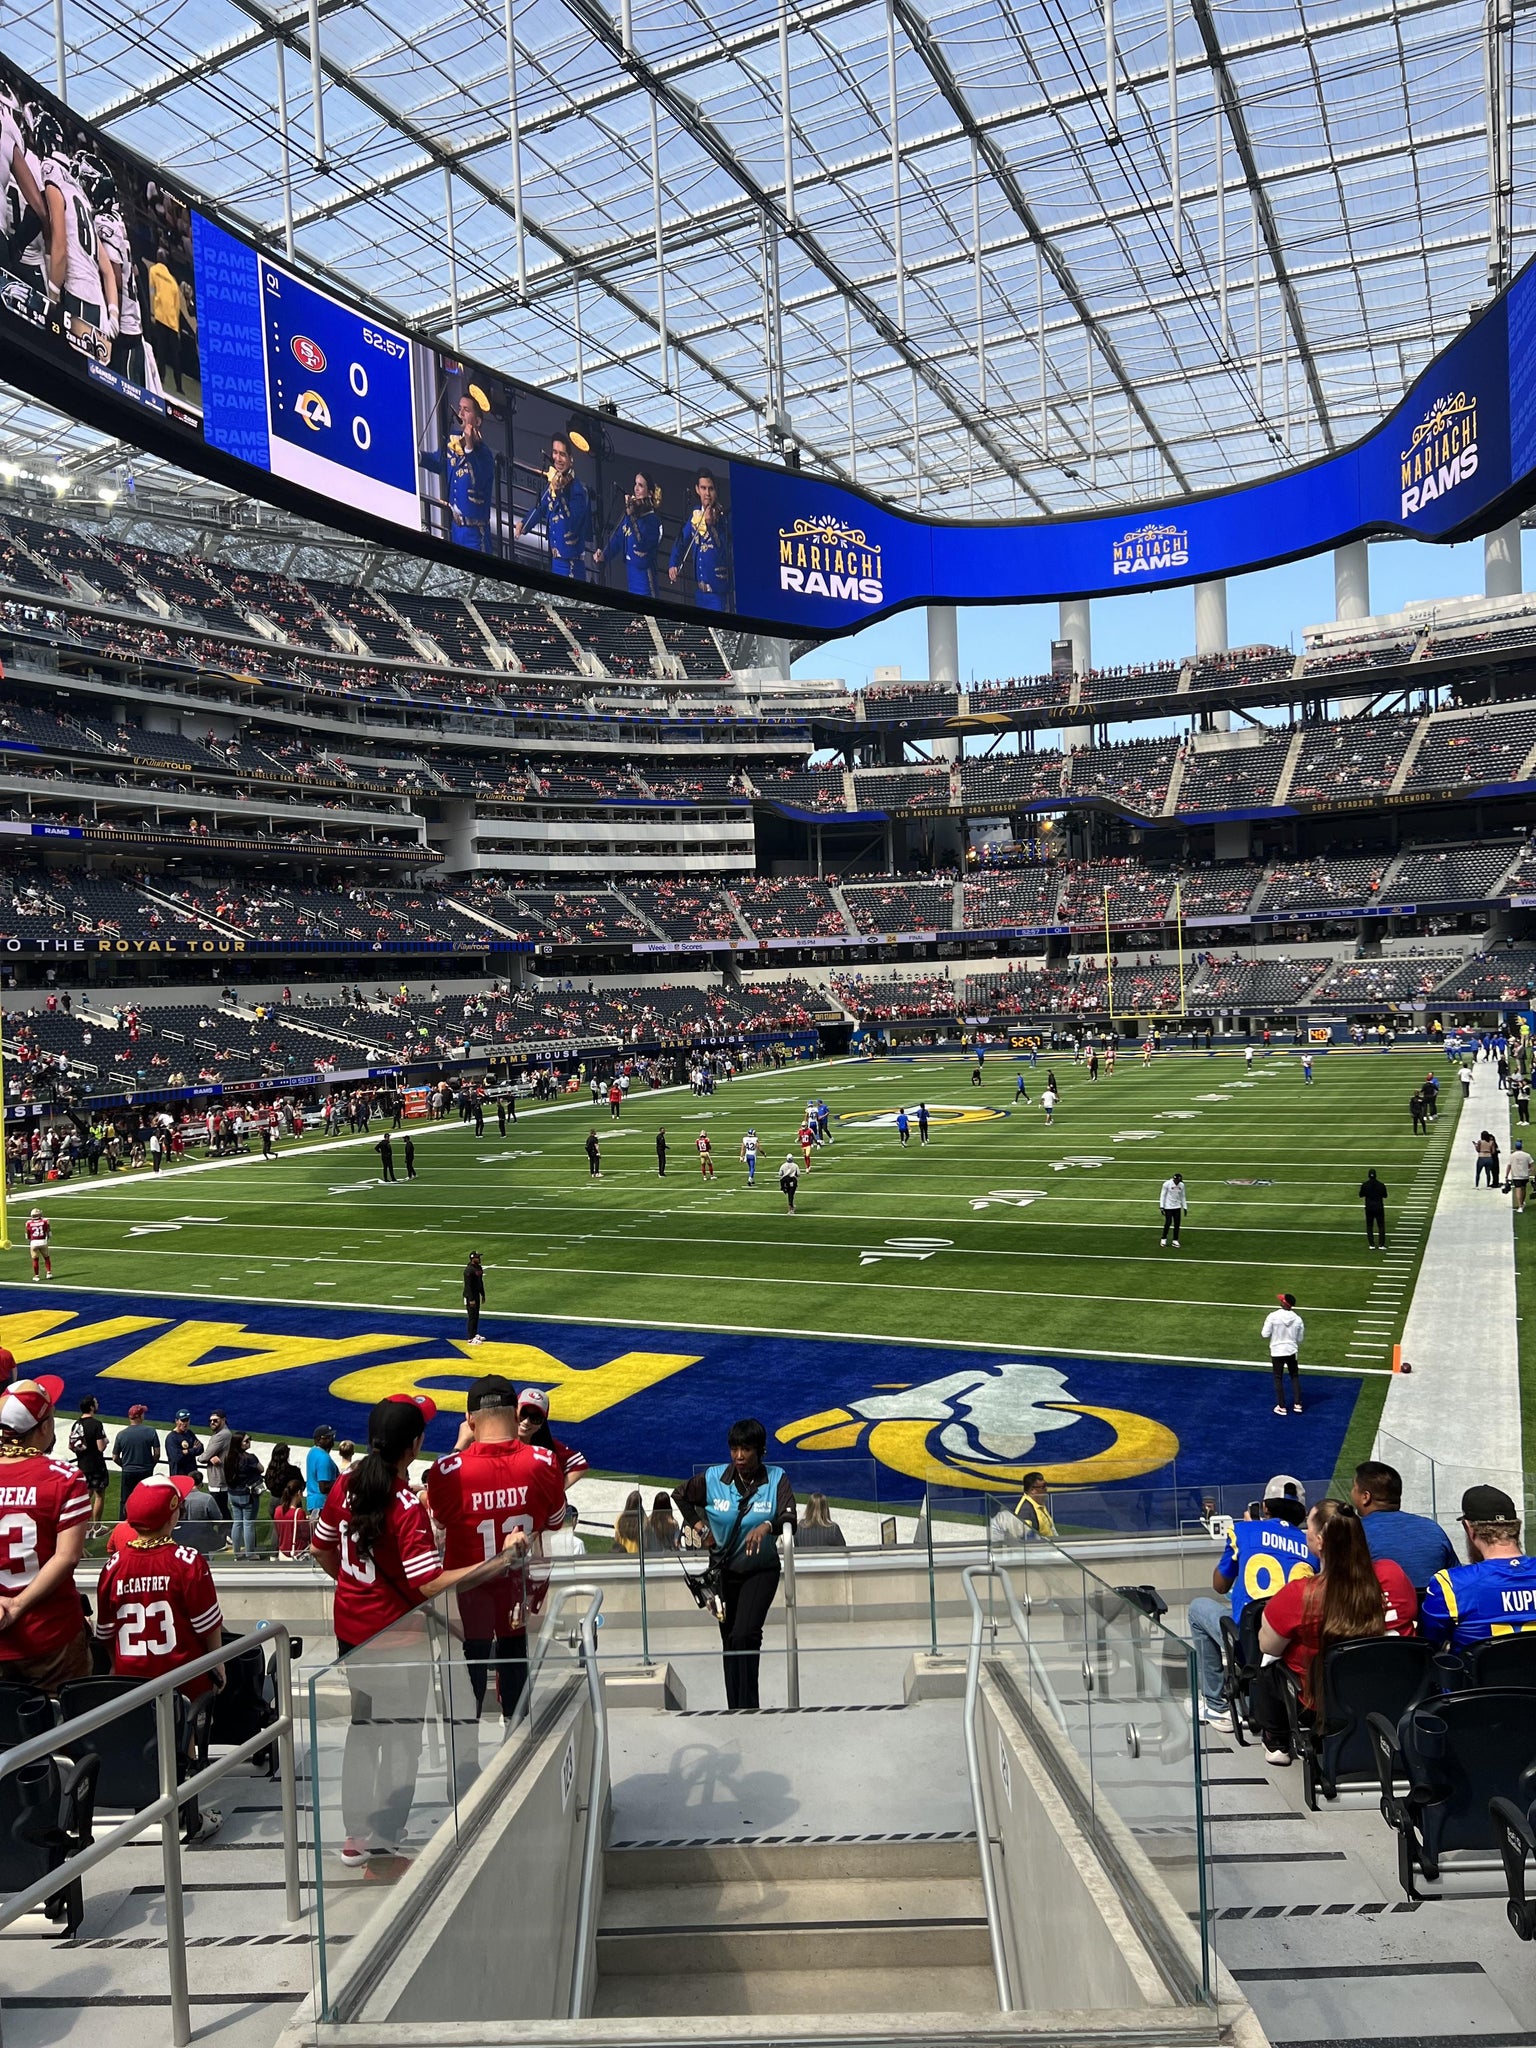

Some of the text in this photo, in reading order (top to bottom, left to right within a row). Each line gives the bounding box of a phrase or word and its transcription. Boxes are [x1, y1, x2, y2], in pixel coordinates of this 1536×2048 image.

[203, 246, 258, 272] RAMS
[204, 264, 258, 290] RAMS
[266, 273, 279, 290] Q1
[206, 283, 260, 308] RAMS
[63, 310, 72, 330] 6
[208, 320, 262, 342] RAMS
[209, 338, 263, 360] RAMS
[362, 327, 406, 360] 52:57
[211, 374, 265, 395] RAMS
[349, 362, 368, 397] 0
[212, 392, 266, 412] RAMS
[214, 428, 268, 447] RAMS
[352, 415, 371, 450] 0
[1401, 410, 1477, 491] MARIACHI
[1401, 443, 1478, 520] RAMS
[779, 539, 882, 579] MARIACHI
[1113, 536, 1188, 561] MARIACHI
[1113, 550, 1189, 575] RAMS
[780, 565, 884, 604] RAMS
[165, 762, 192, 771] TOUR
[502, 794, 525, 802] TOUR
[1312, 804, 1332, 812] SOFI
[1441, 791, 1453, 799] CA
[913, 808, 943, 817] ANGELES
[990, 804, 1017, 812] SEASON
[44, 827, 70, 836] RAMS
[36, 939, 85, 952] THE
[98, 939, 177, 952] ROYAL
[186, 940, 246, 952] TOUR
[660, 1035, 745, 1049] RAMS HOUSE
[1010, 1036, 1041, 1048] 52:57
[489, 1050, 578, 1065] RAMS HOUSE
[193, 1087, 213, 1095] RAMS
[745, 1142, 755, 1151] 42
[968, 1189, 1049, 1211] 20
[859, 1237, 955, 1266] 10
[396, 1488, 420, 1510] 13
[471, 1485, 528, 1511] PURDY
[174, 1545, 198, 1565] 23
[1261, 1531, 1309, 1559] DONALD
[116, 1600, 177, 1656] 23
